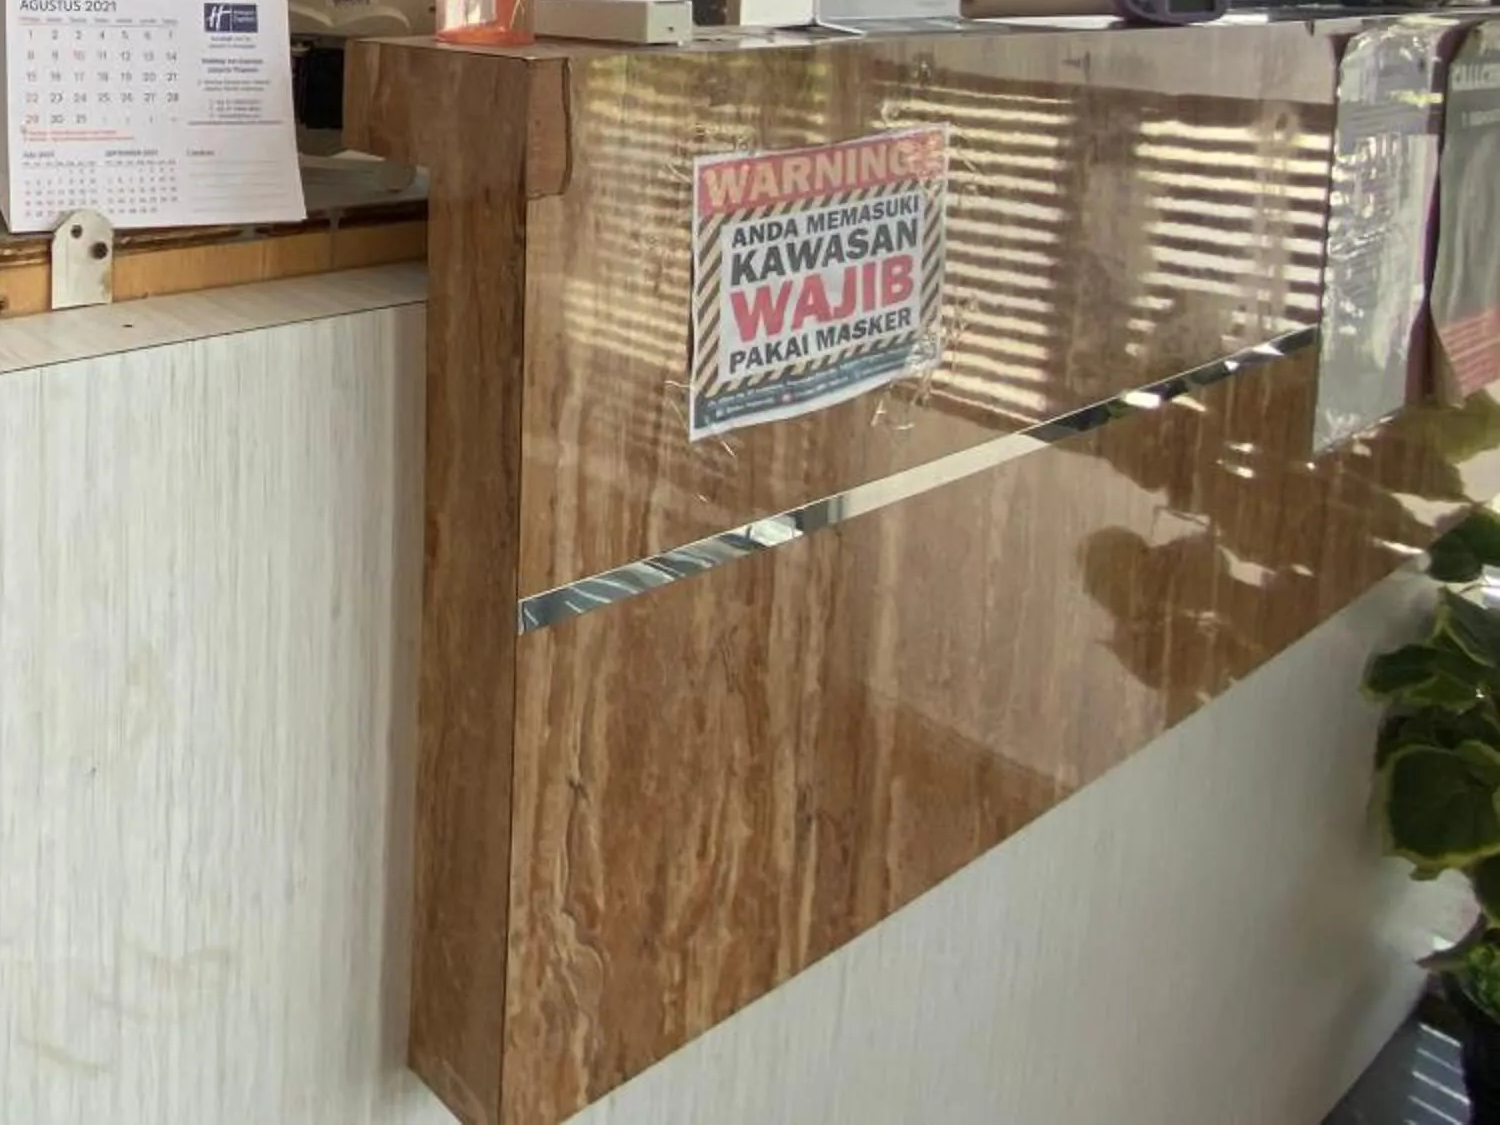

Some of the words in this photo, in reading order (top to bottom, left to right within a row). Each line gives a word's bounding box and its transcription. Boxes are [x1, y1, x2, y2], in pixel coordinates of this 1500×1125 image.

[19, 0, 81, 12] AGUSTUS
[85, 0, 117, 13] 2021
[730, 218, 919, 286] KAWASAN
[731, 218, 799, 249] ANDA
[806, 194, 920, 235] MEMASUKI
[729, 254, 915, 343] WAJIB
[729, 334, 810, 375] PAKAI
[816, 307, 912, 352] MASKER
